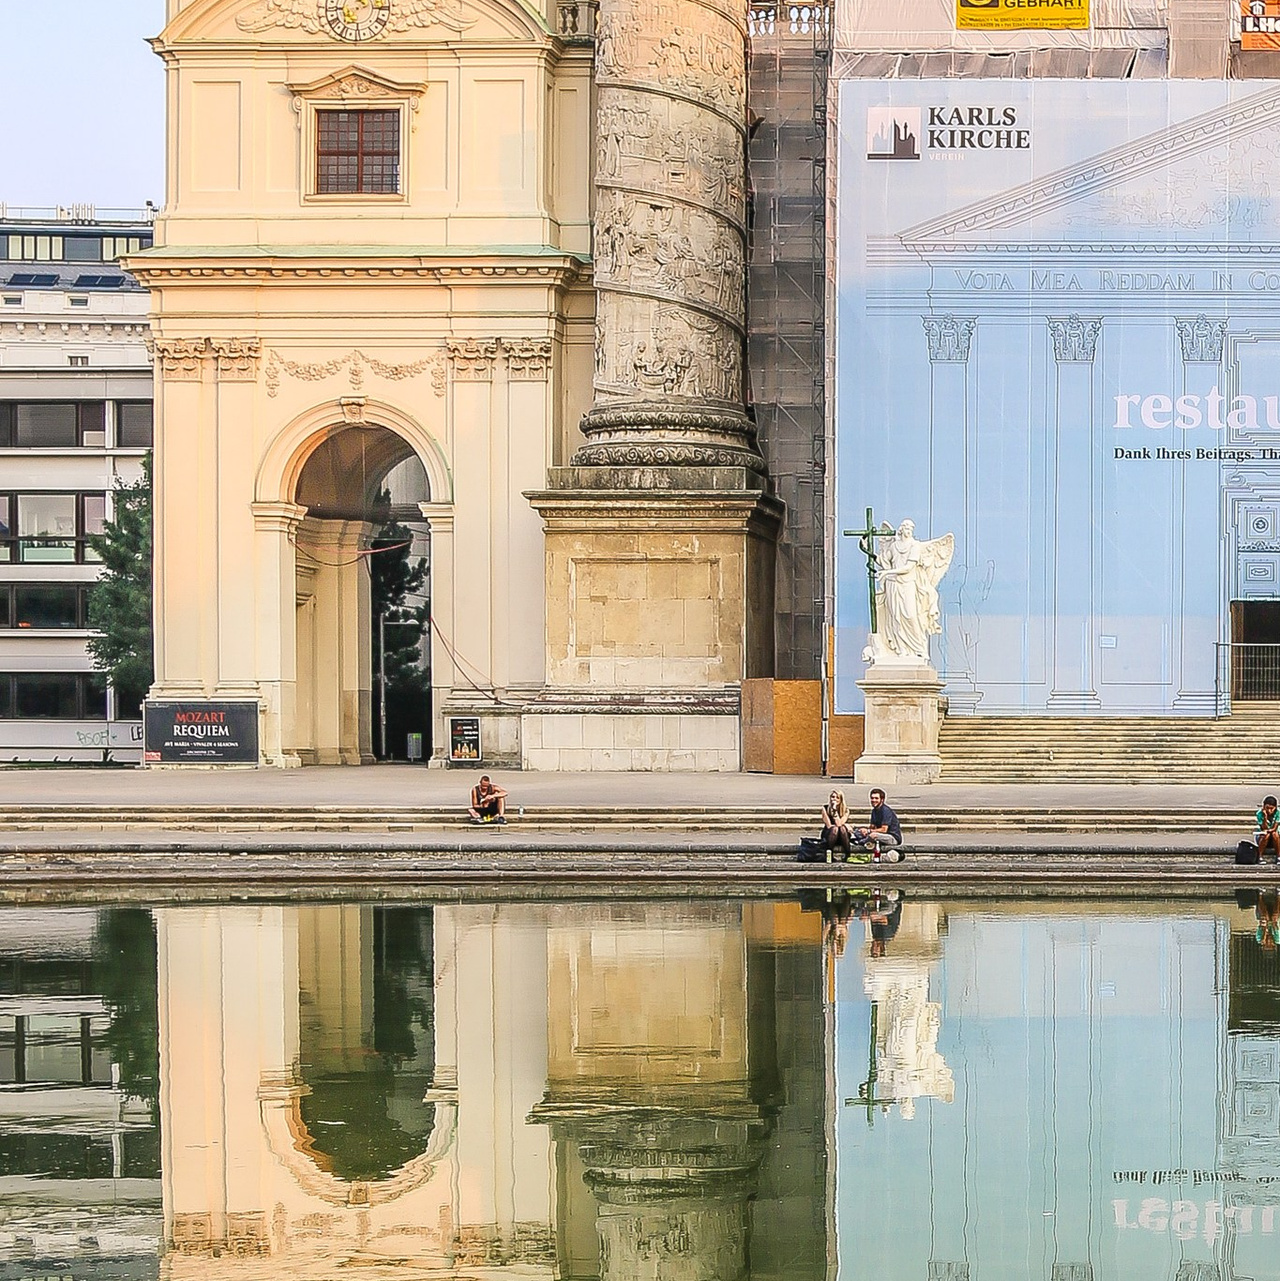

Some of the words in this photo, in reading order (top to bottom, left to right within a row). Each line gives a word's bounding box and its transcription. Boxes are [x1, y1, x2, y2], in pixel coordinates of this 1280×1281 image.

[928, 106, 1016, 127] KARLS
[928, 129, 1030, 149] KIRCHE
[929, 153, 965, 161] VEREIN
[1114, 447, 1151, 460] Dank
[1156, 447, 1191, 460] Ihres
[1196, 447, 1255, 463] Beitrags.
[175, 711, 226, 723] MOZART
[173, 724, 230, 739] REQUIEM
